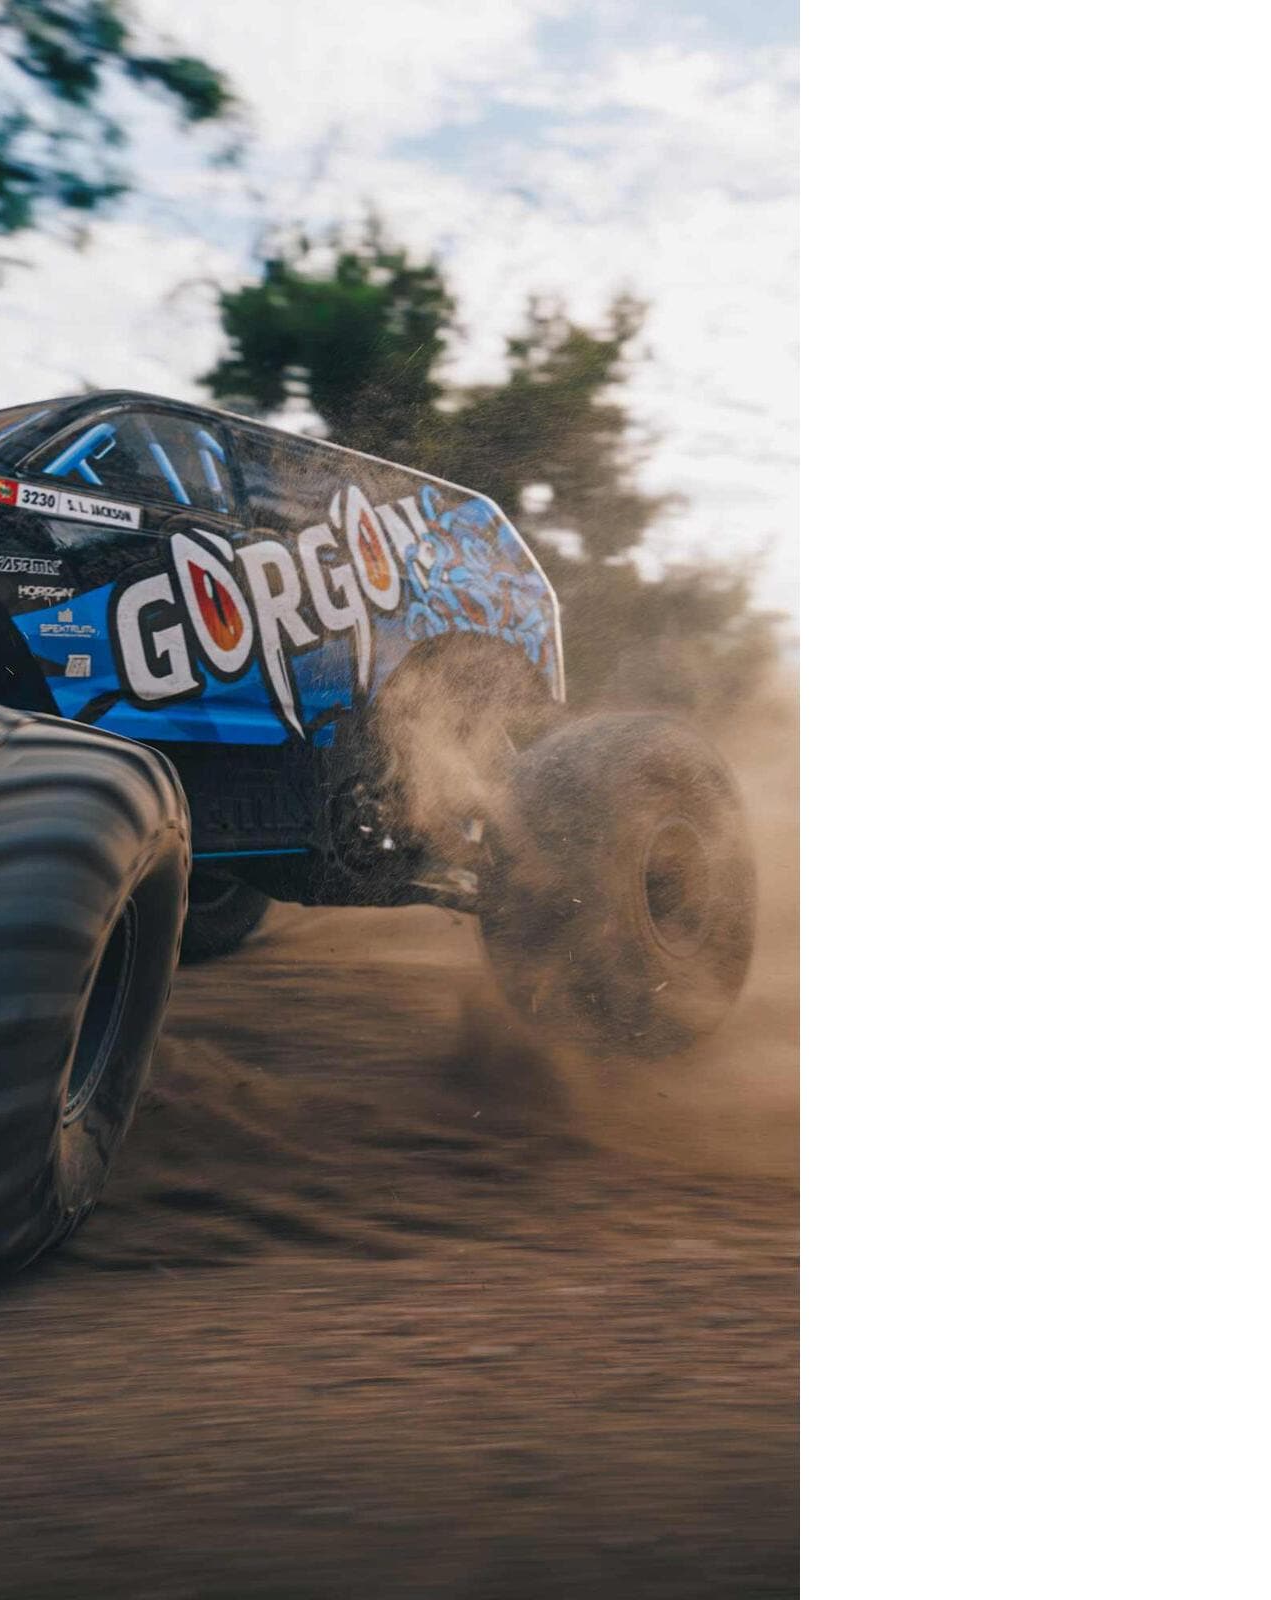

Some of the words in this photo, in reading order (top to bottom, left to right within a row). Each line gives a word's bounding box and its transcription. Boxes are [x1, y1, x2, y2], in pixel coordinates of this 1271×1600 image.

[22, 489, 56, 508] 3230
[91, 503, 133, 522] JACKSON
[116, 485, 436, 741] GORGON
